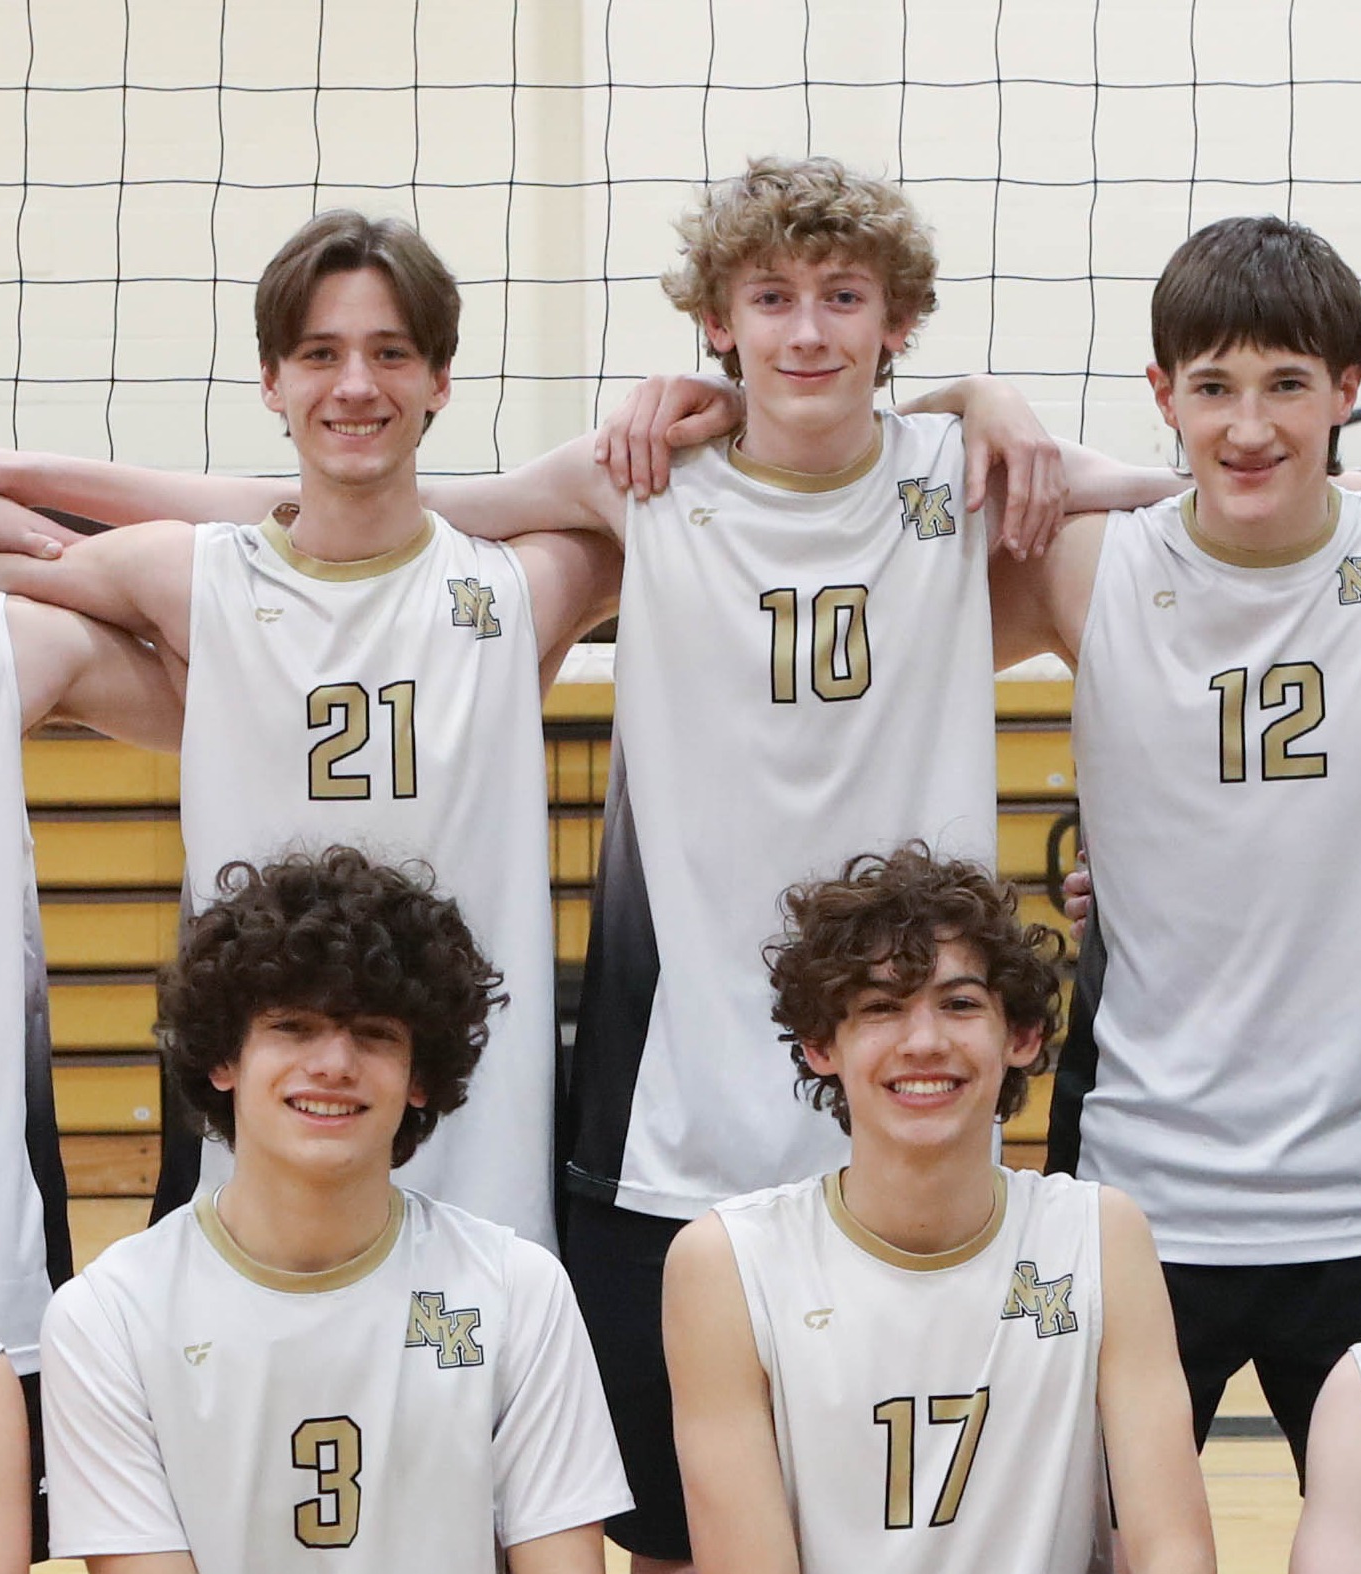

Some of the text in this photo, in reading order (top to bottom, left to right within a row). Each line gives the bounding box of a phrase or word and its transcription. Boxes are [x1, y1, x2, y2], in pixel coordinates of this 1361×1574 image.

[897, 477, 956, 541] NK
[447, 577, 502, 641] NK
[759, 584, 872, 704] 10
[306, 680, 417, 801] 21
[1209, 660, 1327, 784] 12
[403, 1290, 484, 1369] NK
[1000, 1260, 1078, 1338] NK
[291, 1414, 362, 1550] 3
[873, 1385, 990, 1530] 17
